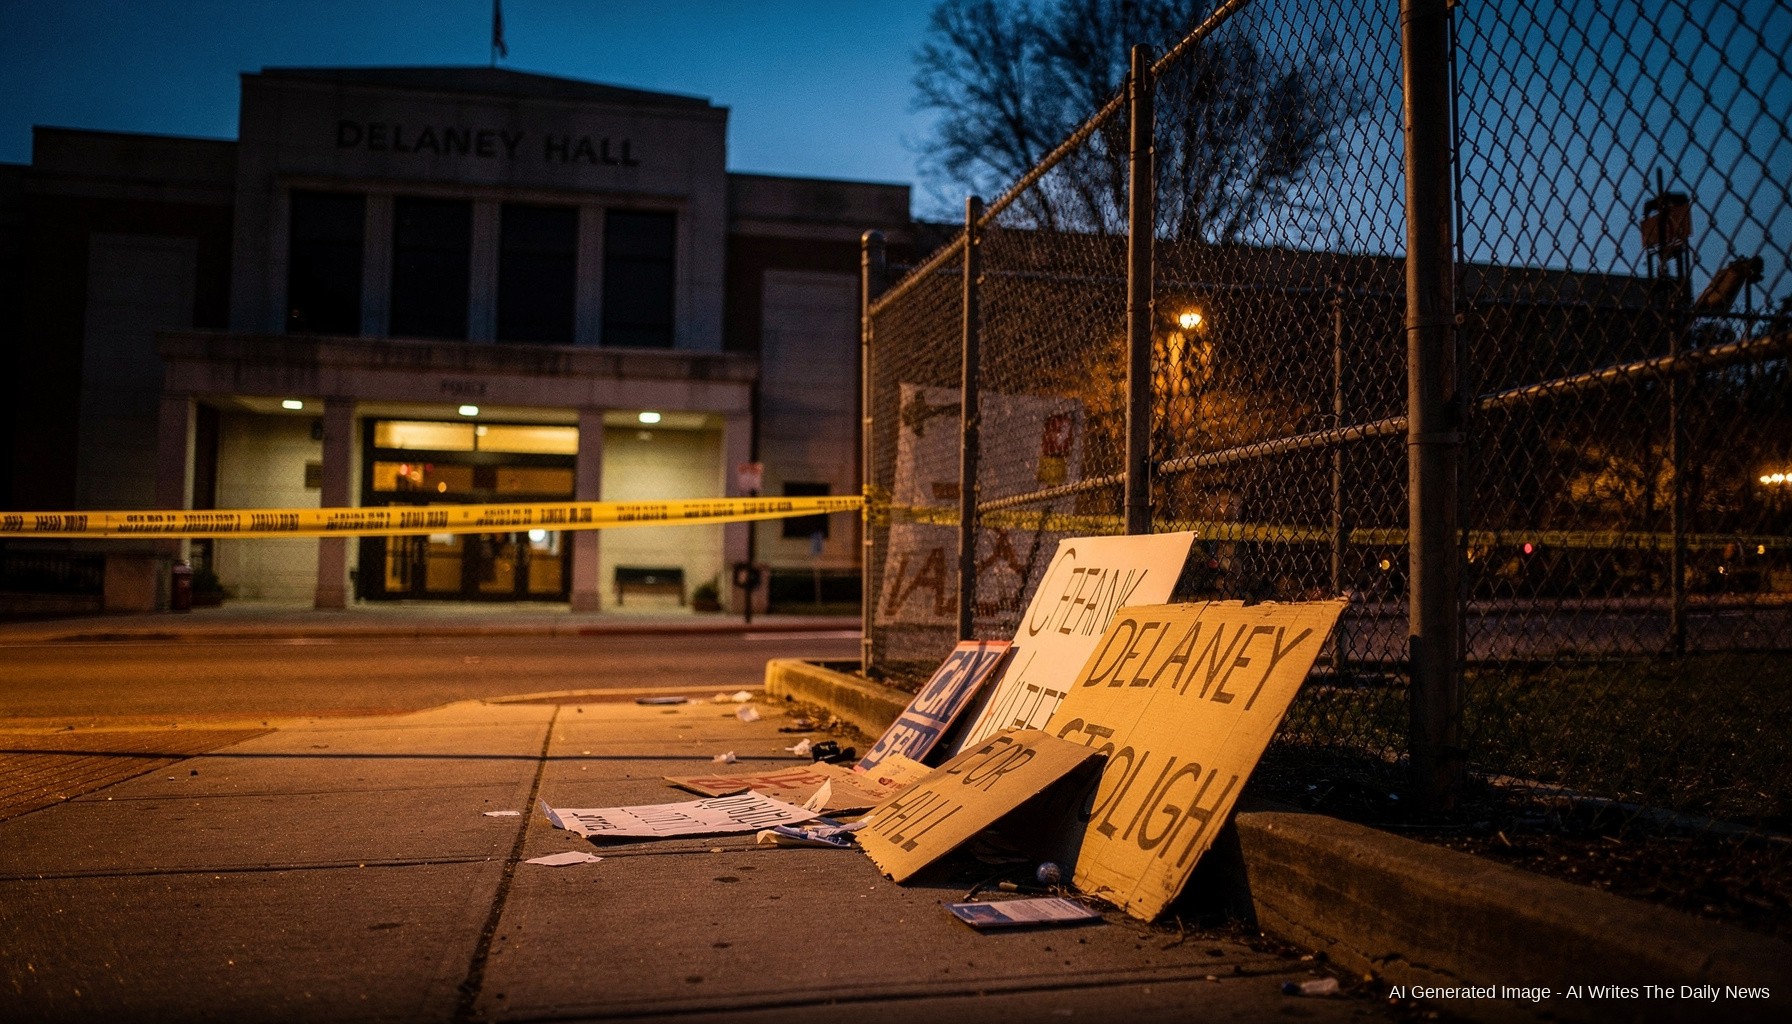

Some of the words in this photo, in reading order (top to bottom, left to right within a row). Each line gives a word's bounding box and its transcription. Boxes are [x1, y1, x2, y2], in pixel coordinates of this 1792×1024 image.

[336, 120, 525, 160] DELANEY
[544, 135, 641, 167] HALL
[1082, 618, 1314, 712] DELANEY
[872, 784, 964, 853] HALL
